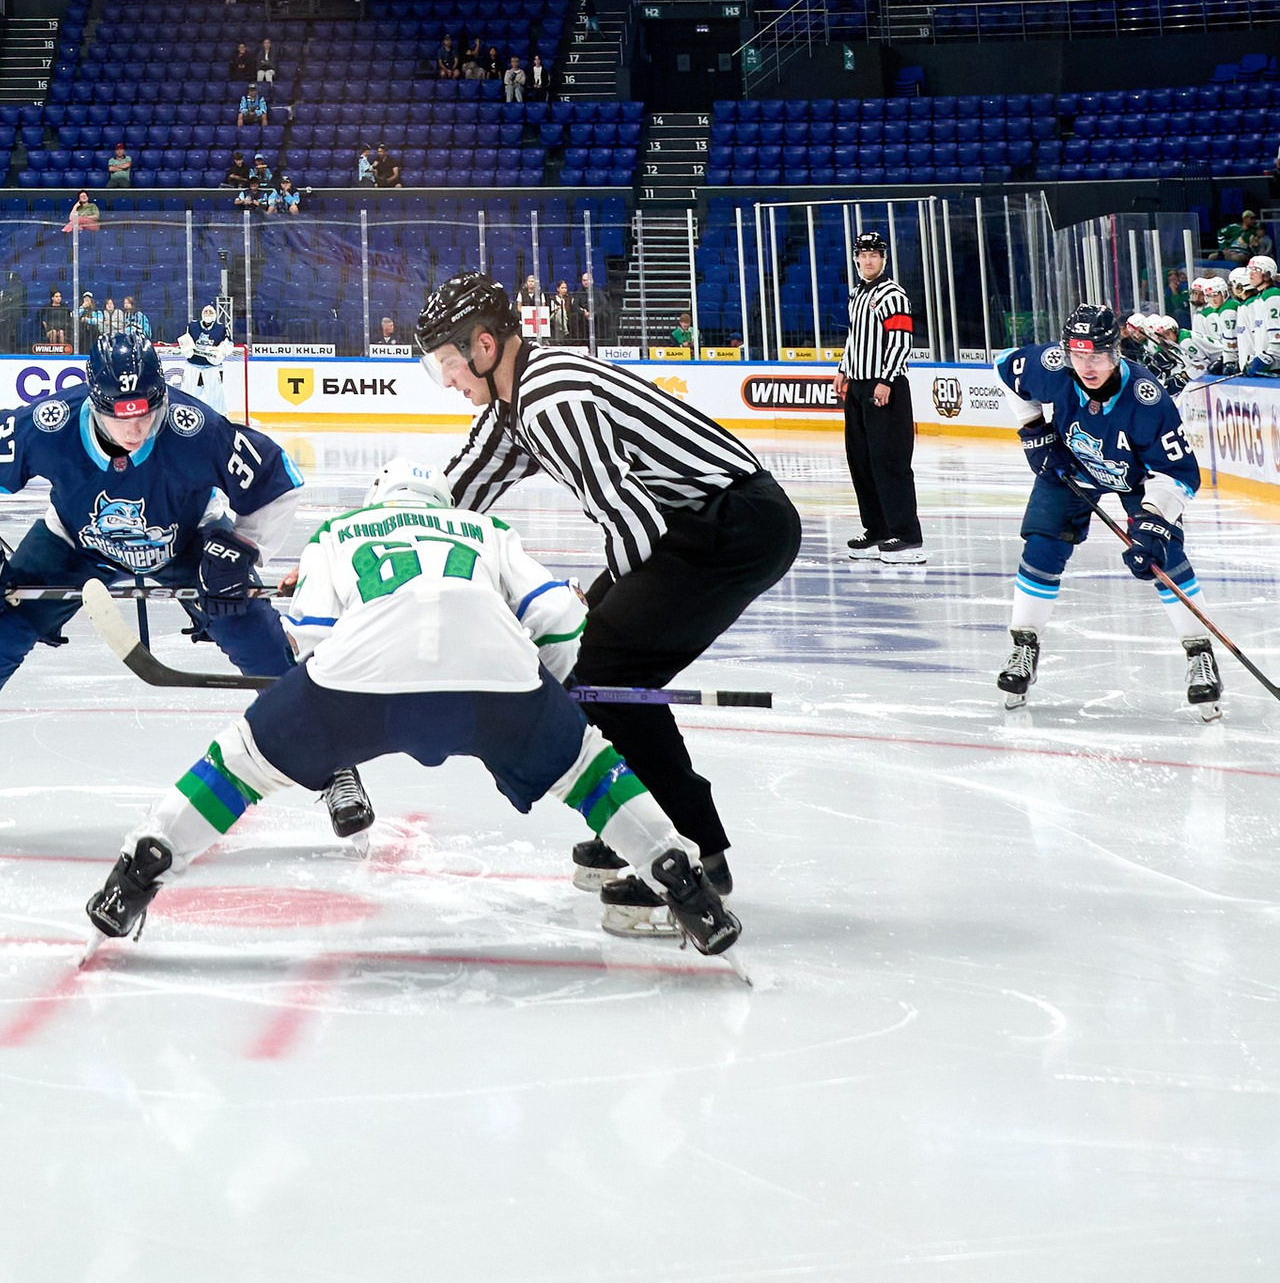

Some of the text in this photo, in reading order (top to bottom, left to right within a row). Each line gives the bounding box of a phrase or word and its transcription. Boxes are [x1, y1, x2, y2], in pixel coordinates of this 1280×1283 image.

[645, 7, 740, 17] H2 H3
[49, 21, 58, 29] 19
[44, 40, 54, 49] 18
[42, 59, 52, 68] 17
[569, 55, 579, 63] 17
[37, 80, 48, 89] 16
[565, 76, 575, 84] 16
[653, 117, 708, 125] 14 14
[650, 142, 707, 150] 13 13
[647, 166, 704, 174] 12 12
[645, 190, 654, 198] 11
[35, 344, 64, 353] WINLINE
[255, 346, 333, 355] KHL.RU KHL.RU
[372, 347, 409, 355] KHL.RU
[605, 349, 632, 358] Haier
[961, 352, 984, 361] KHL.RU
[120, 375, 139, 392] 37
[322, 378, 397, 395] БАНК
[751, 382, 838, 405] WINLINE
[937, 377, 957, 401] 80
[970, 399, 999, 410] ХОККЕЮ
[1116, 431, 1131, 451] A
[1160, 426, 1193, 461] 53
[227, 431, 262, 490] 37
[337, 513, 484, 544] KHABIBULLIN
[352, 535, 481, 603] 67
